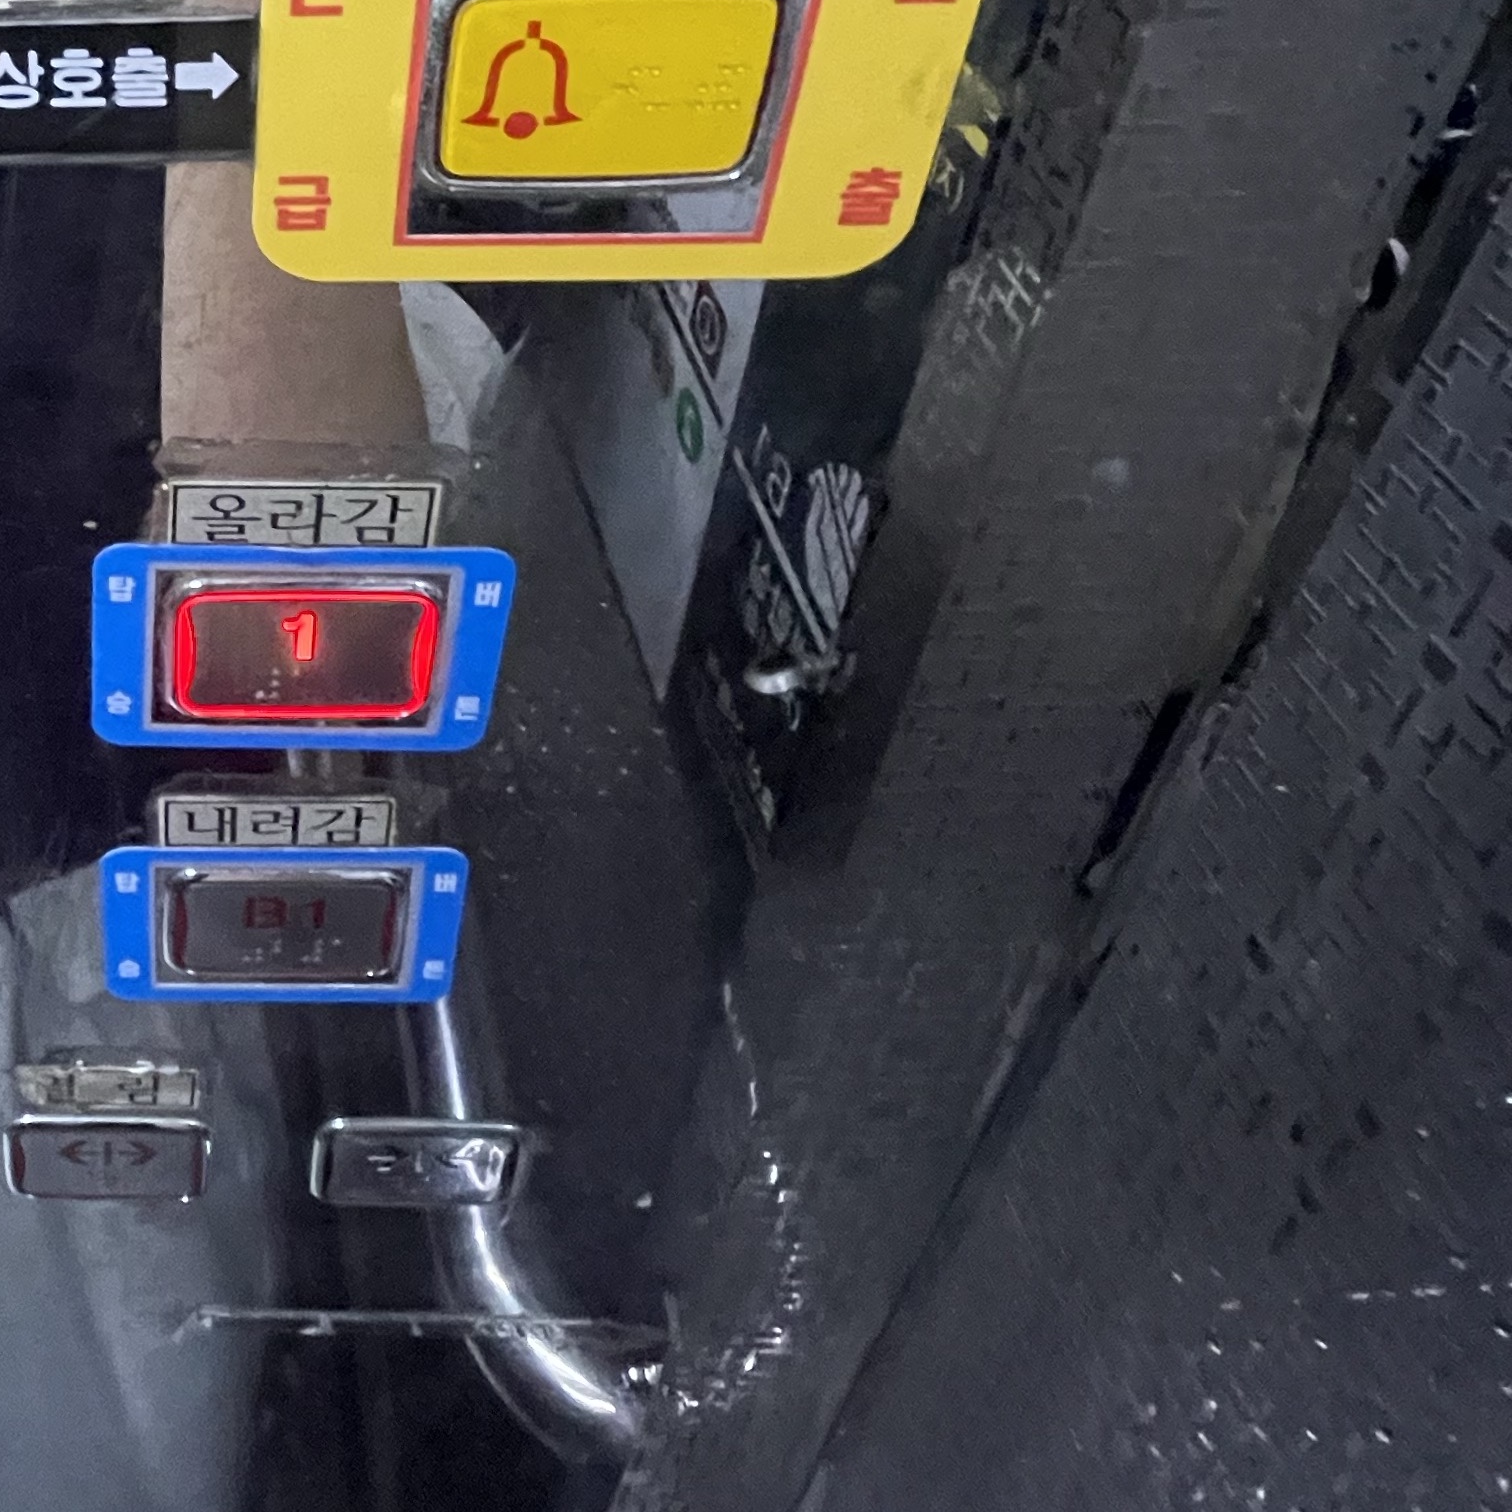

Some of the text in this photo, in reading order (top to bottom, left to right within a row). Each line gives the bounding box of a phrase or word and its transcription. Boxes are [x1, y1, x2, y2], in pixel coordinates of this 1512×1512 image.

[190, 492, 415, 545] 올라감
[281, 608, 319, 662] 1
[183, 805, 379, 844] 내려감
